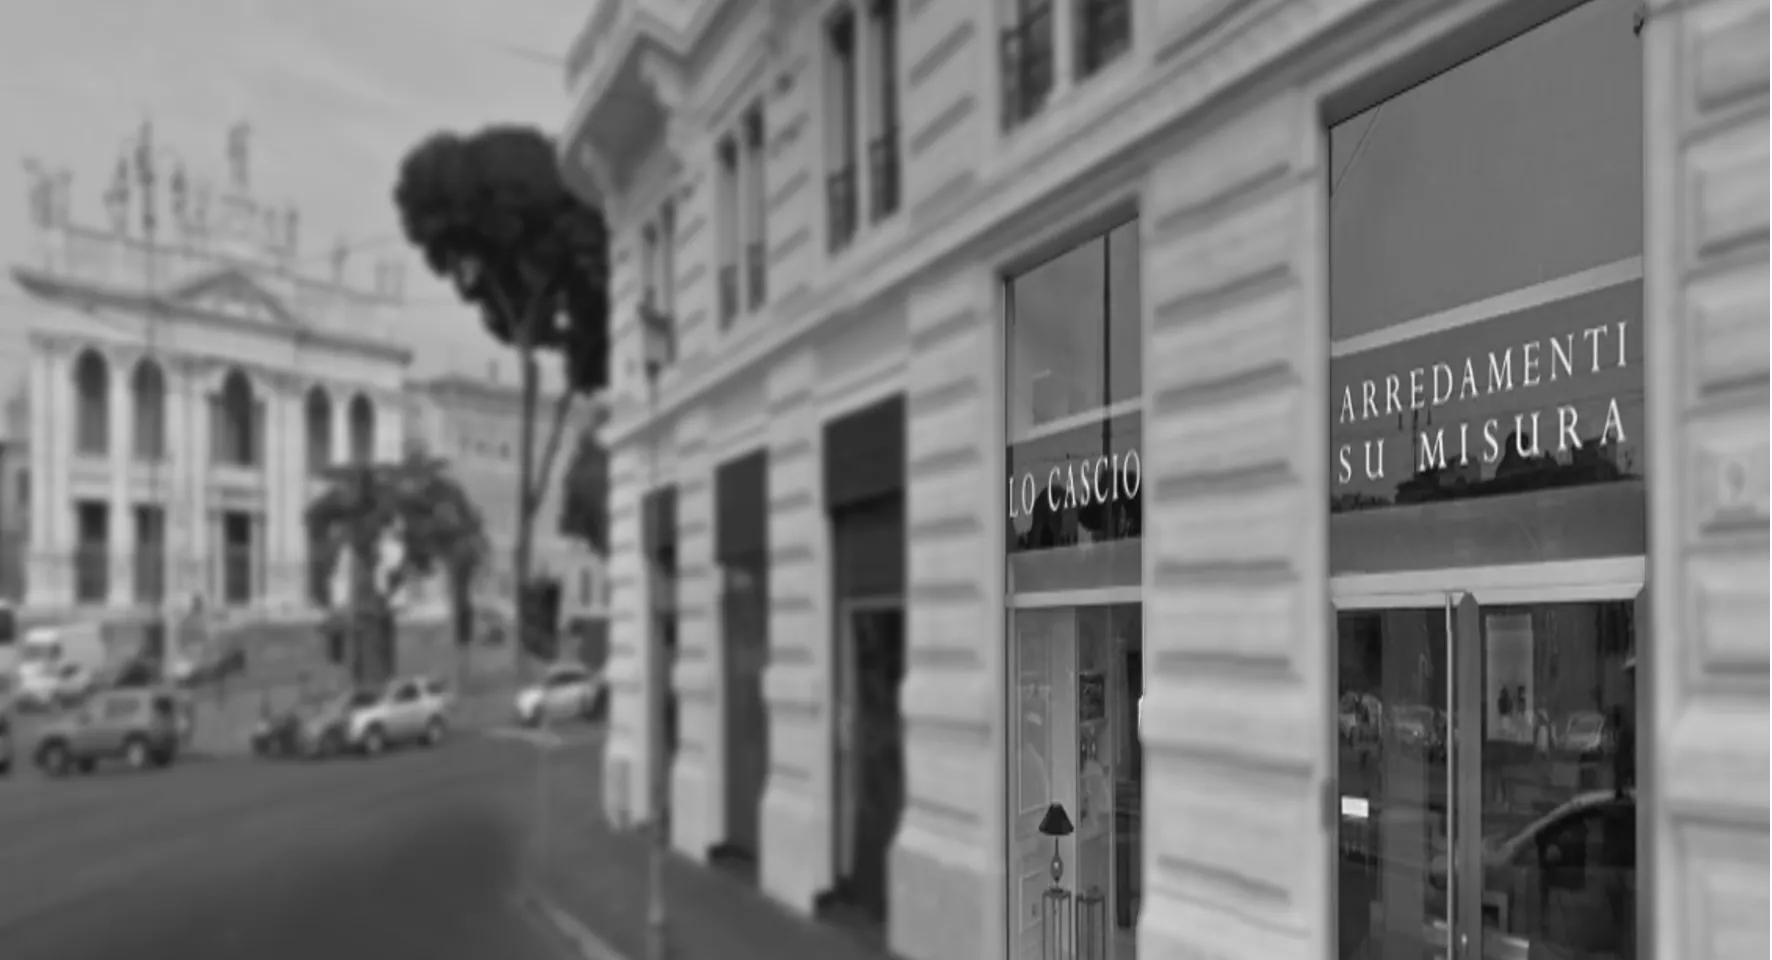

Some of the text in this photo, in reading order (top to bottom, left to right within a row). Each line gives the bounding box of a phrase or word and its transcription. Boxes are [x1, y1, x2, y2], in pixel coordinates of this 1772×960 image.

[1340, 320, 1627, 424] ARREDAMENTI
[1009, 448, 1140, 518] LO CASCIO
[1338, 397, 1626, 484] SU MISURA
